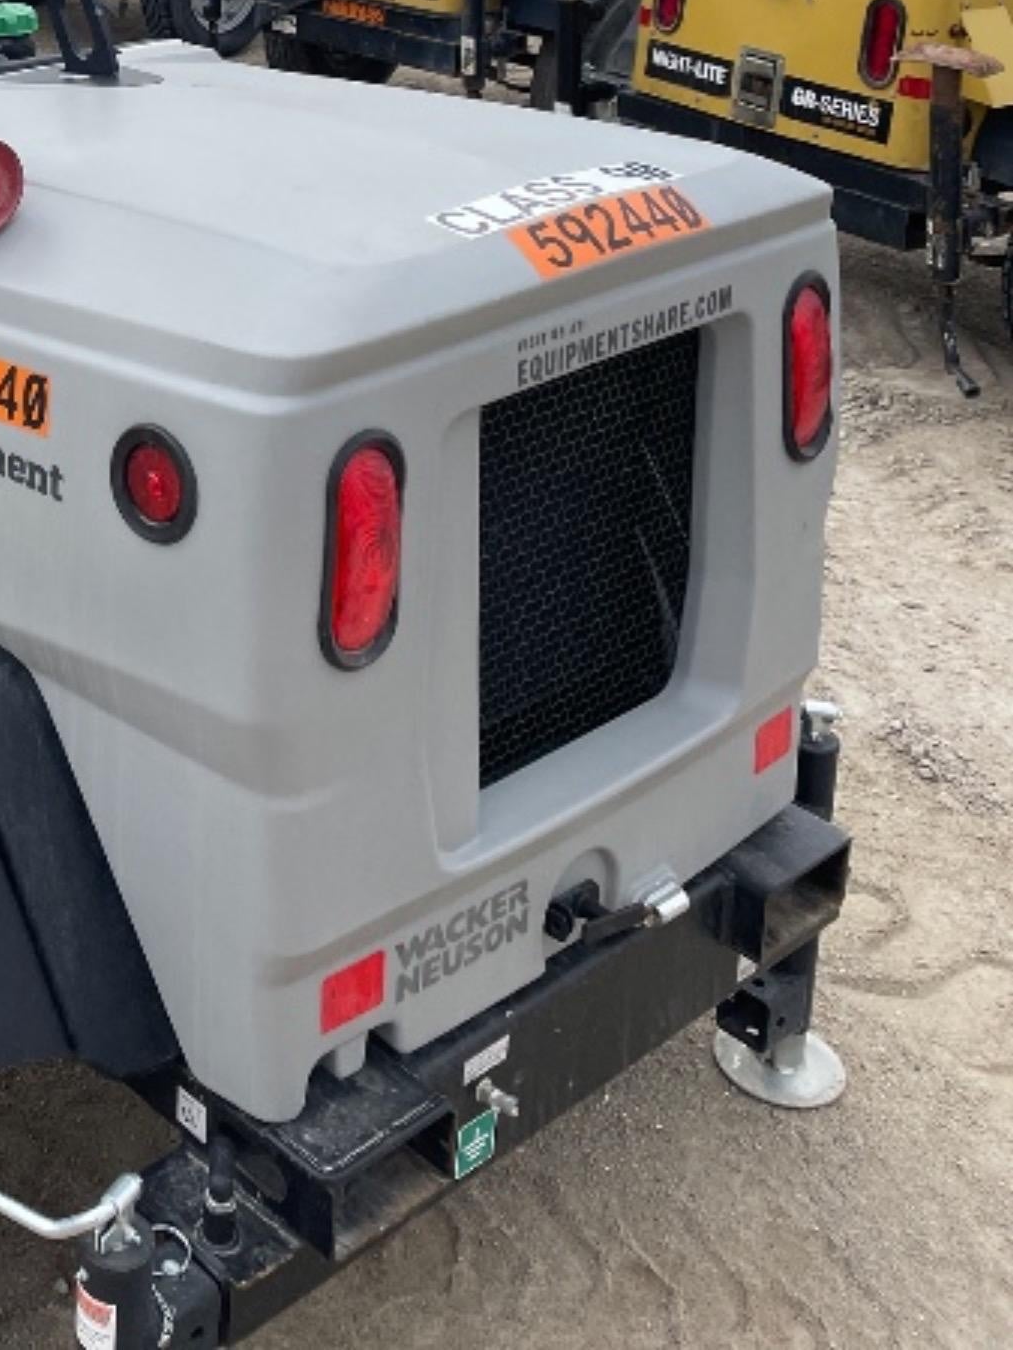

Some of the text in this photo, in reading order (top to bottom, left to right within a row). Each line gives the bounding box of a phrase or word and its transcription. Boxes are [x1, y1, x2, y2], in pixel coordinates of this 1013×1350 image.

[652, 47, 729, 85] NIGHT-LITE
[790, 85, 880, 127] GR-SERIES
[437, 176, 603, 236] CLASS
[526, 185, 703, 269] 592440
[516, 284, 733, 388] EQUIPMENTSHARE.COM
[394, 879, 530, 970] WACKER
[394, 906, 529, 1003] NEUSON
